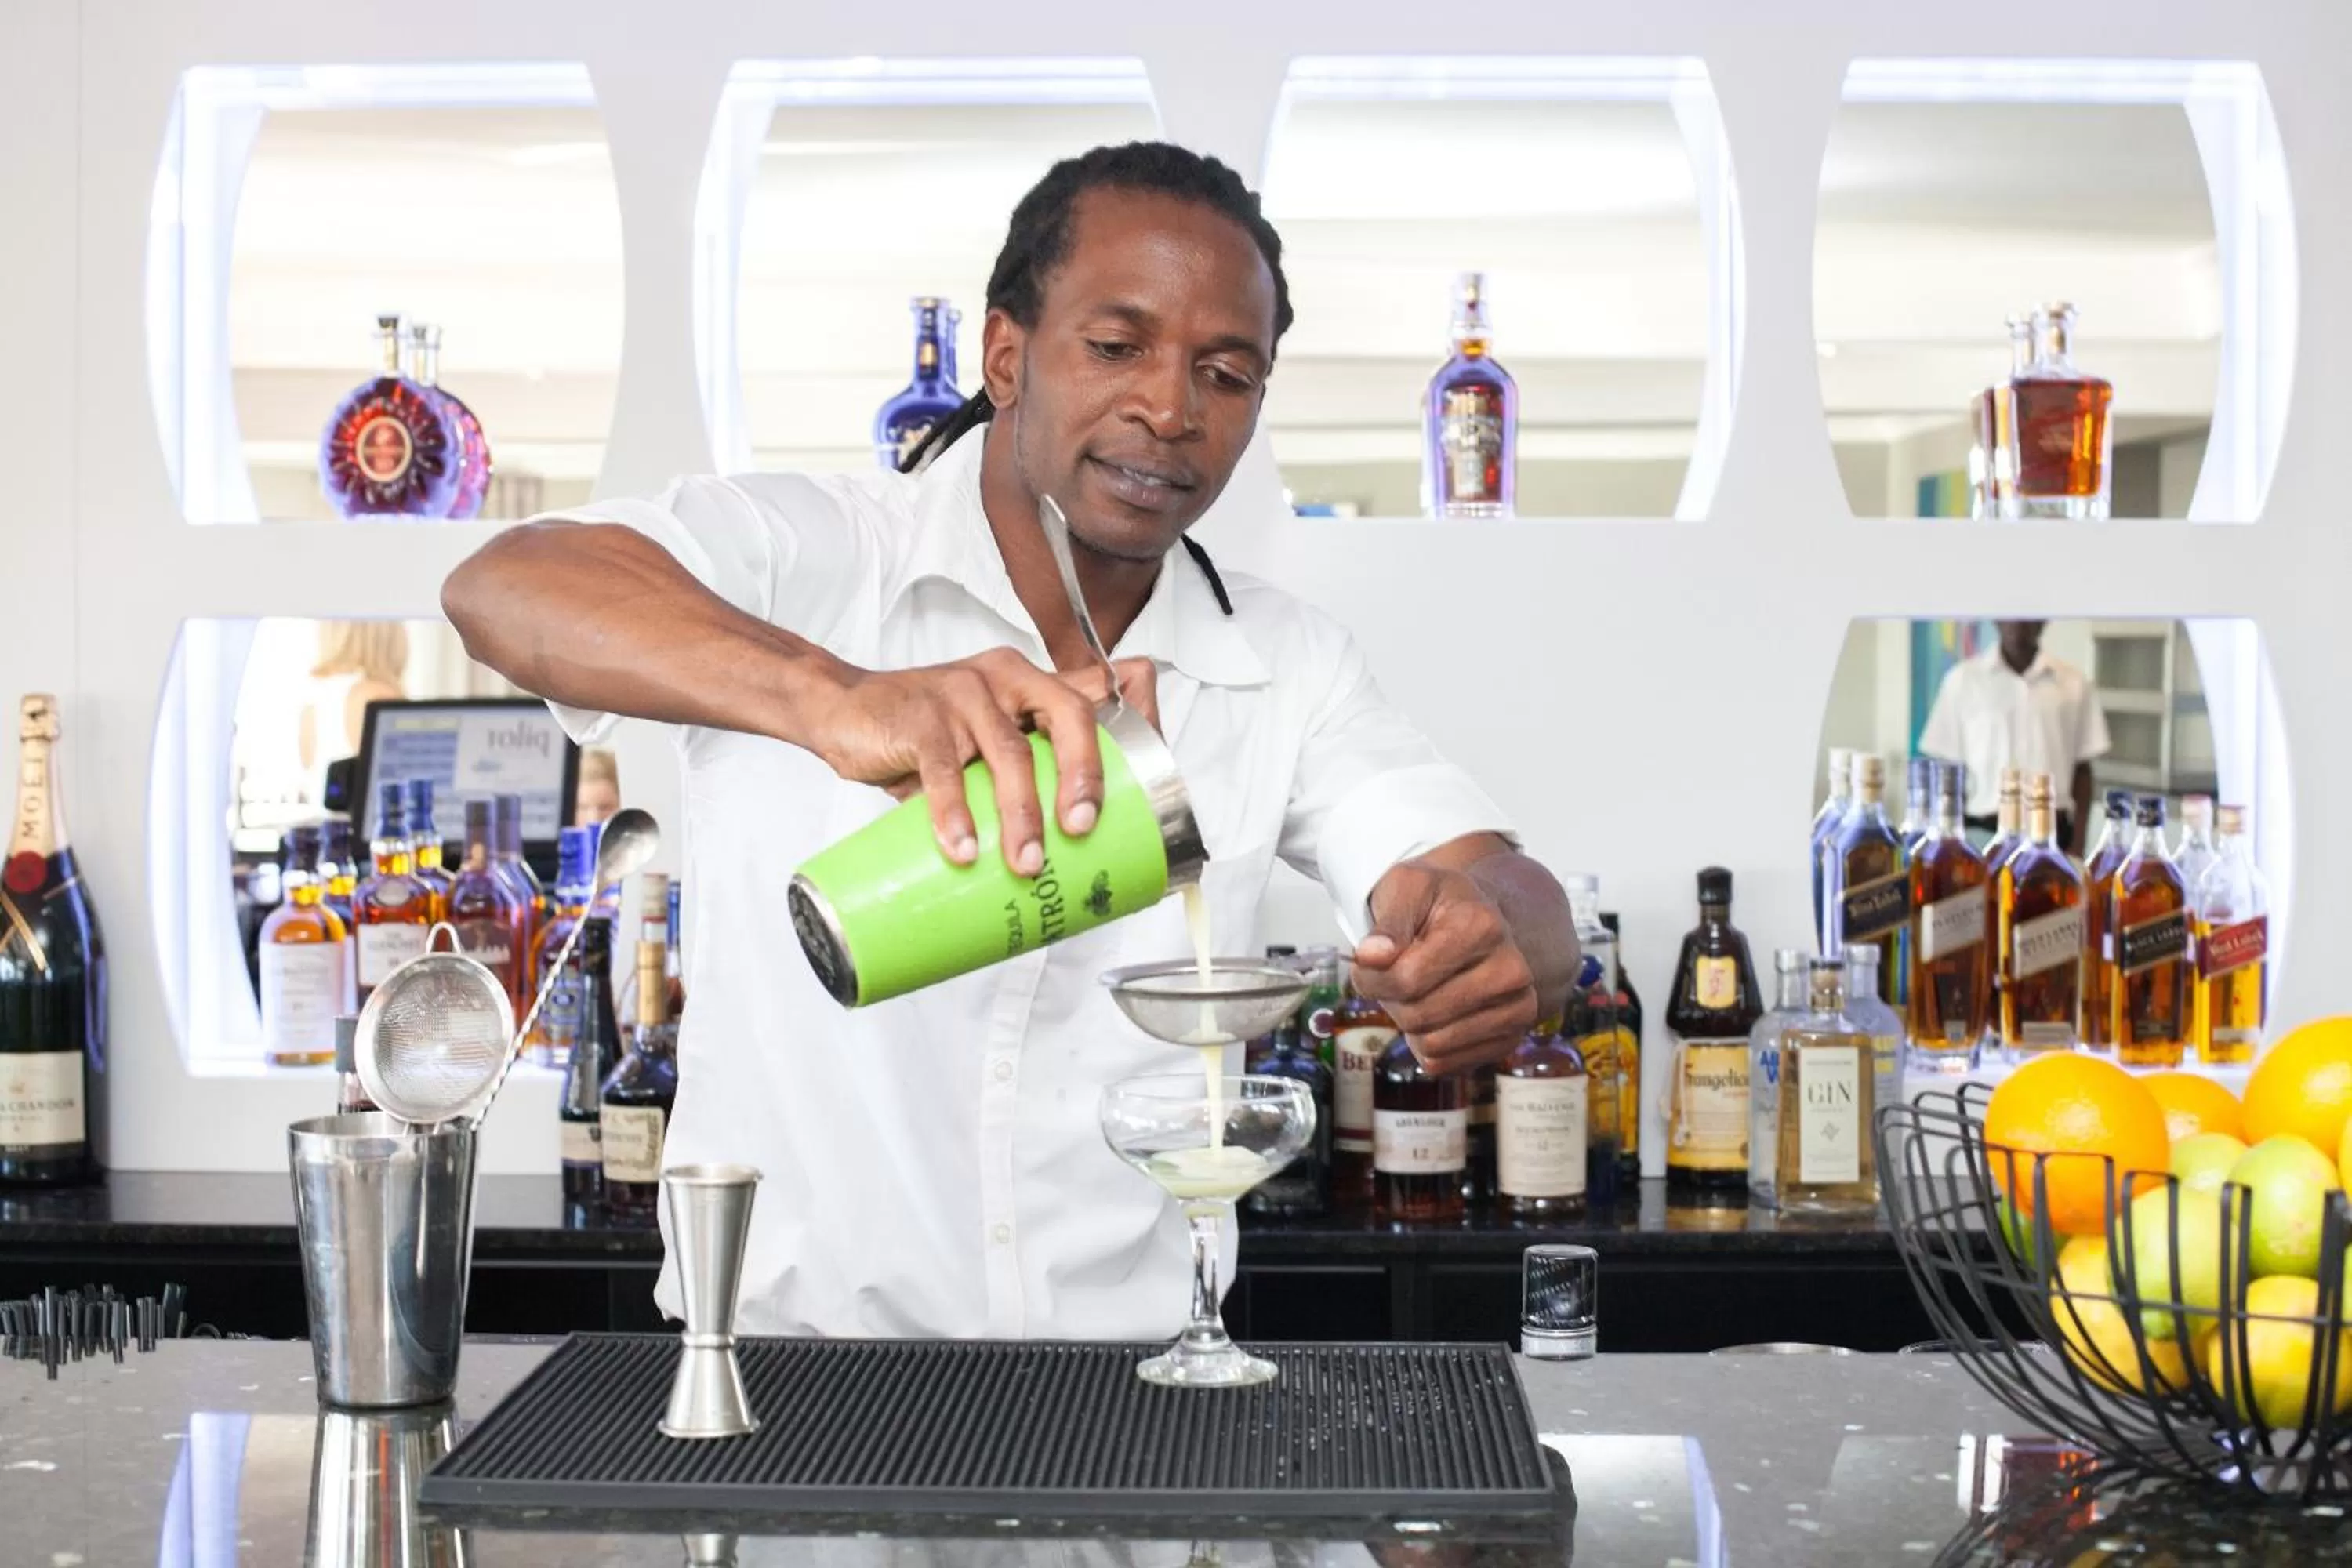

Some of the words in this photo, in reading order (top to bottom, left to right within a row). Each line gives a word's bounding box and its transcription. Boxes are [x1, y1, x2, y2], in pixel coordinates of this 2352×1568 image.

[1030, 858, 1065, 943] ATRÓ
[1342, 1051, 1374, 1072] BE
[1807, 1080, 1854, 1105] GIN
